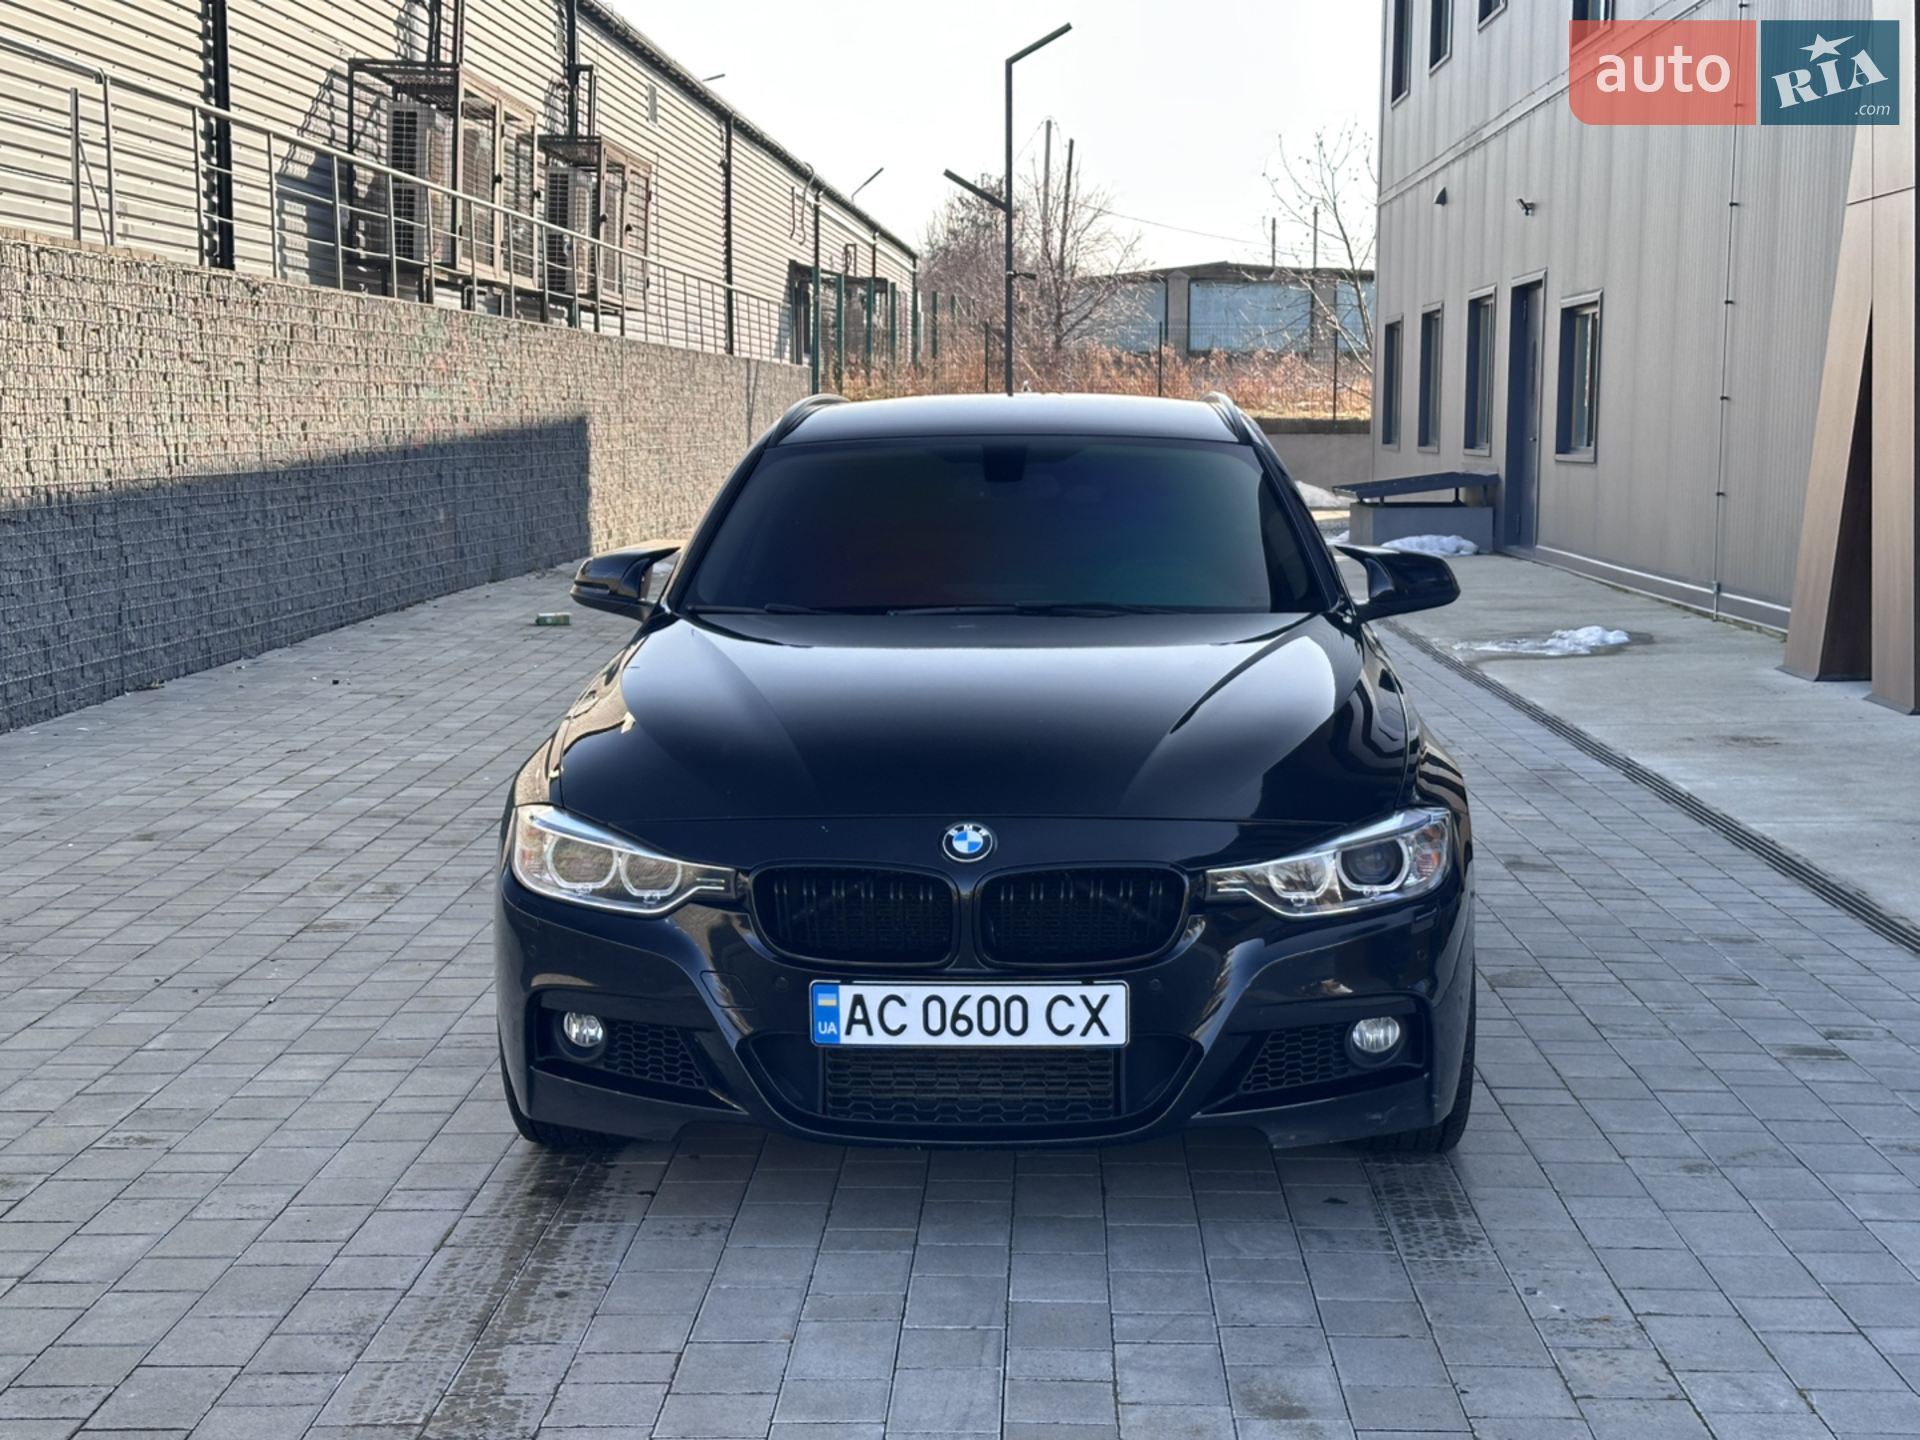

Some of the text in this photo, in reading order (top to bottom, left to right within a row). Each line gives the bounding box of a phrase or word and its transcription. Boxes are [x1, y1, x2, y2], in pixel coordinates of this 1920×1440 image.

[818, 1021, 838, 1035] UA
[844, 993, 1111, 1037] AC 0600 CX
